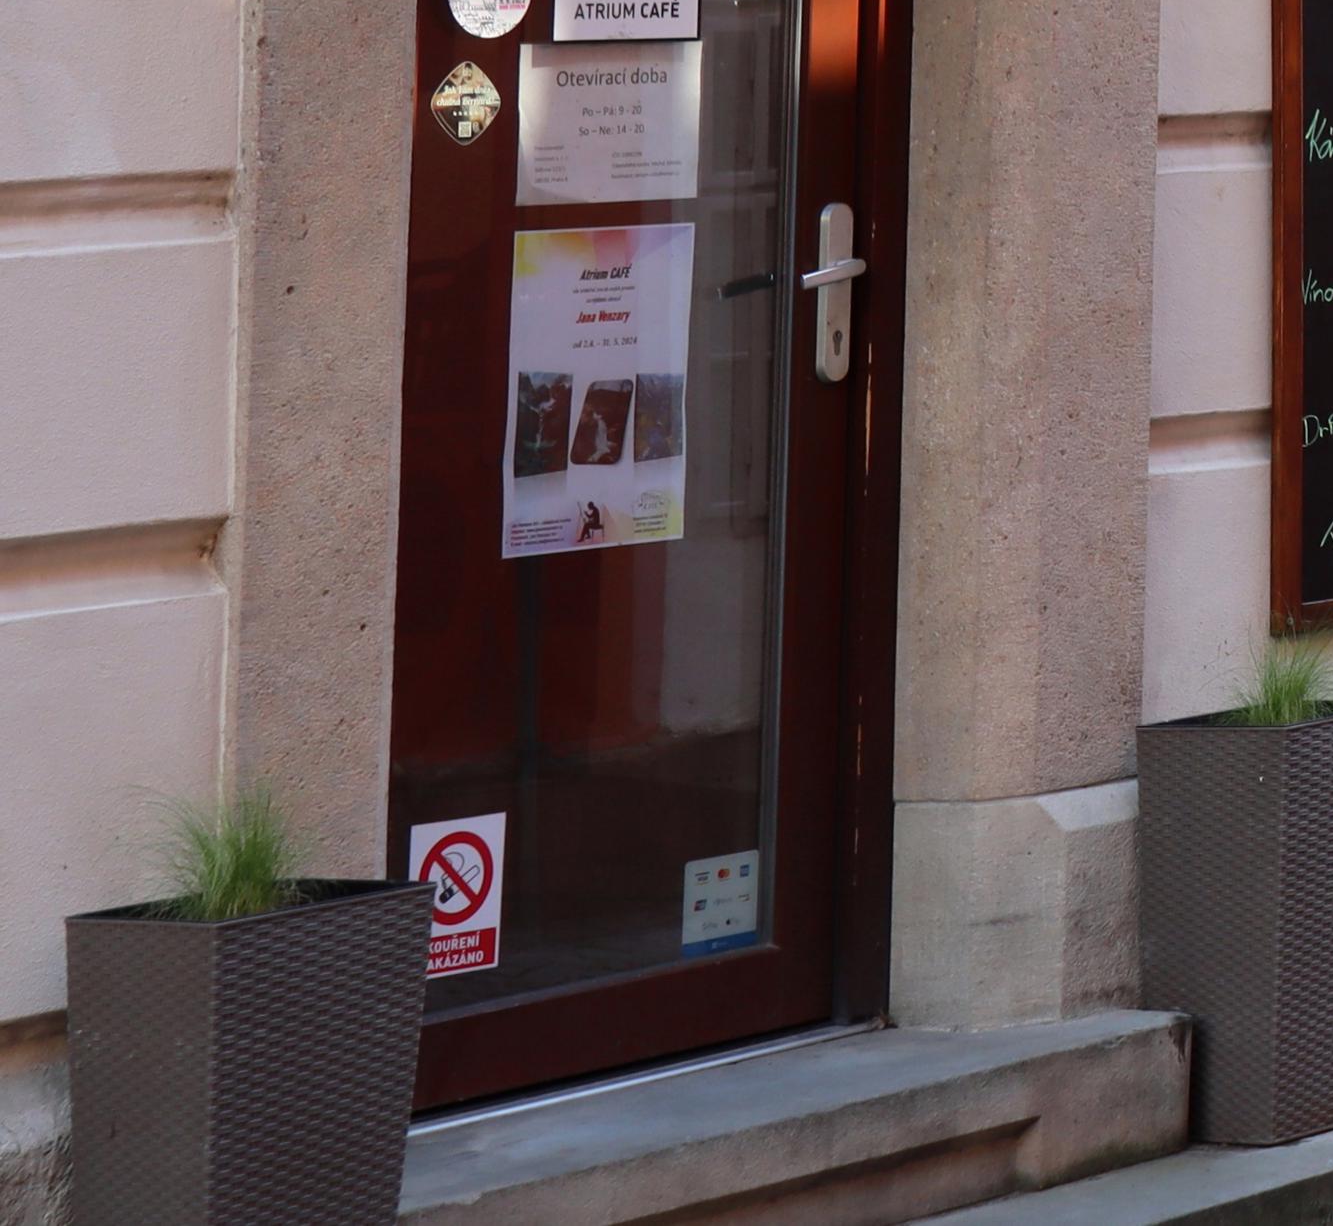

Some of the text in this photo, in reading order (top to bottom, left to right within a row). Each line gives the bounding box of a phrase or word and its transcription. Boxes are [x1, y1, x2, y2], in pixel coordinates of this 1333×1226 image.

[574, 2, 636, 20] ATRIUM
[556, 66, 669, 87] Otevírací doba
[631, 104, 643, 115] 20
[634, 123, 646, 135] 20
[426, 949, 485, 971] AKÁZÁNO
